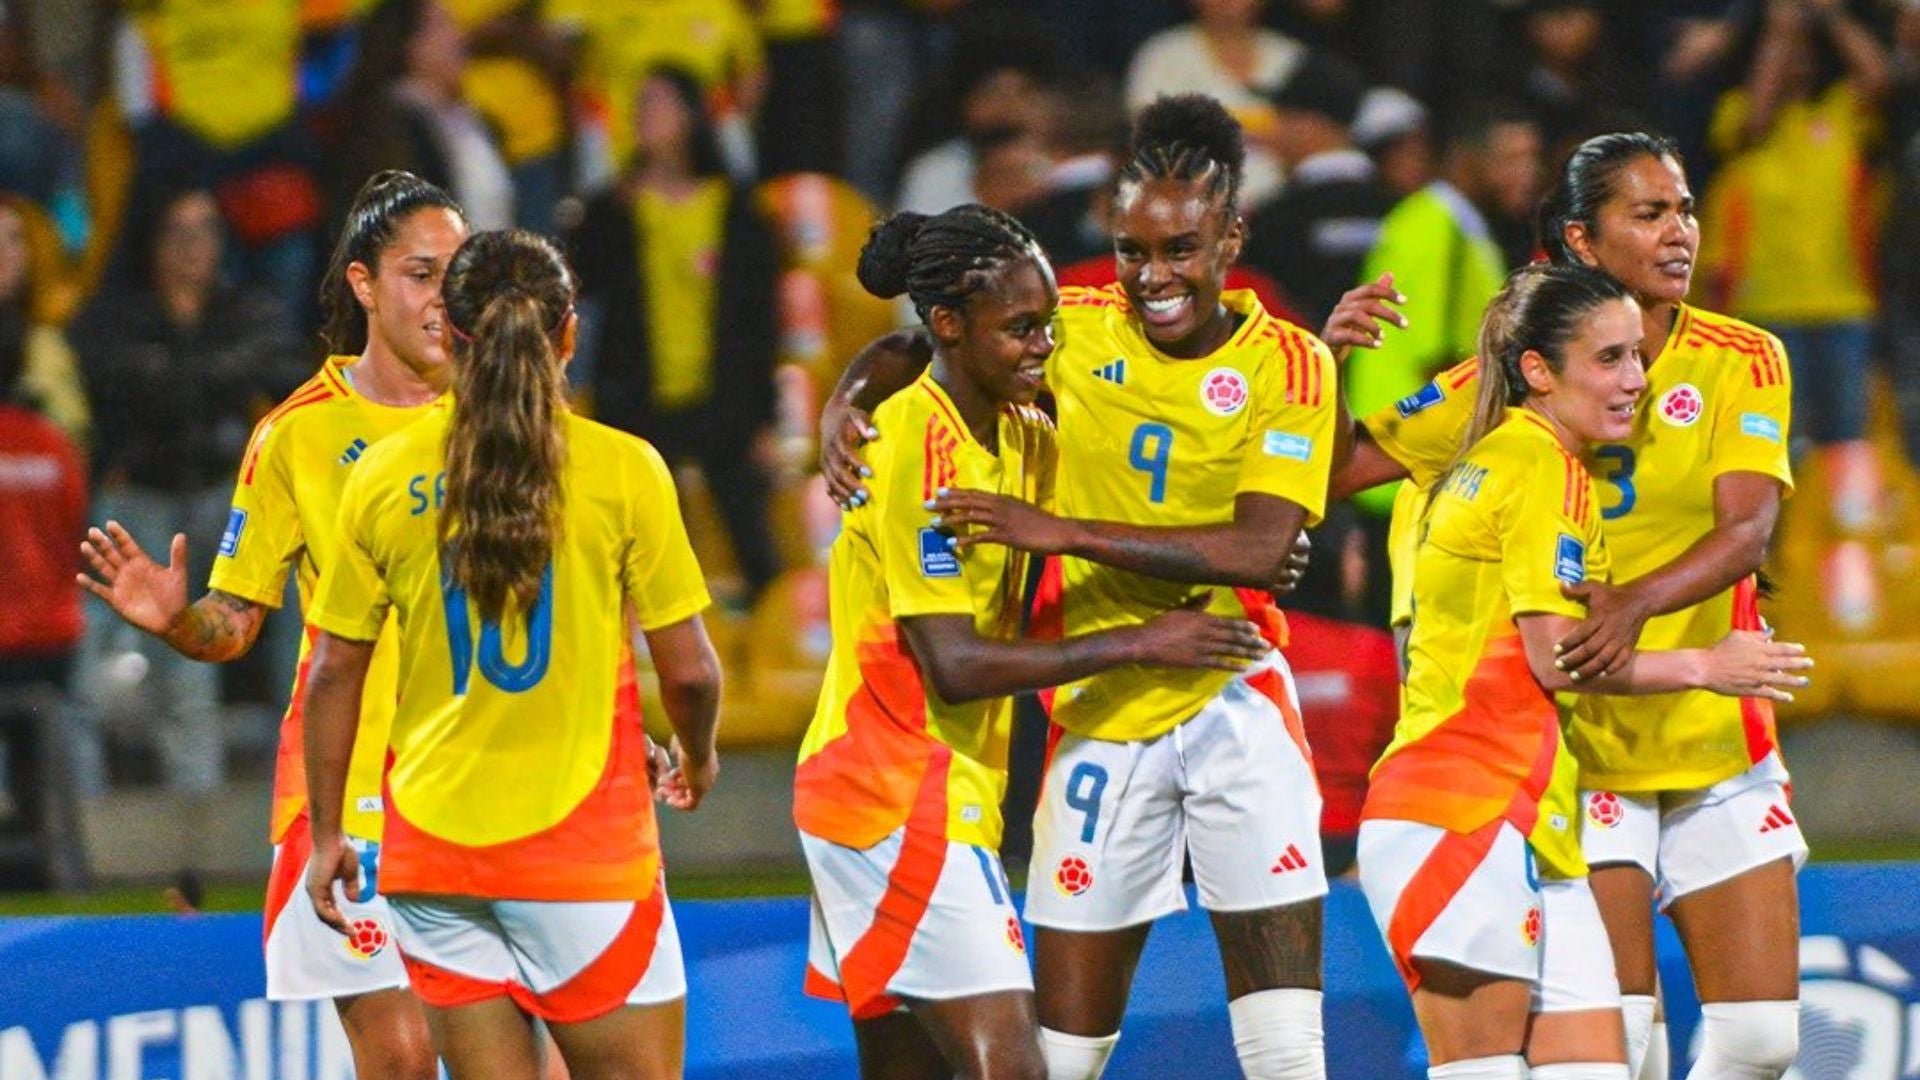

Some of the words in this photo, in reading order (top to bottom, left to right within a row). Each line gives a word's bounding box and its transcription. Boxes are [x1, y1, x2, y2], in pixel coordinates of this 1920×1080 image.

[1128, 422, 1173, 504] 9
[1598, 445, 1636, 520] 3
[439, 530, 554, 695] 10
[1065, 761, 1108, 844] 9
